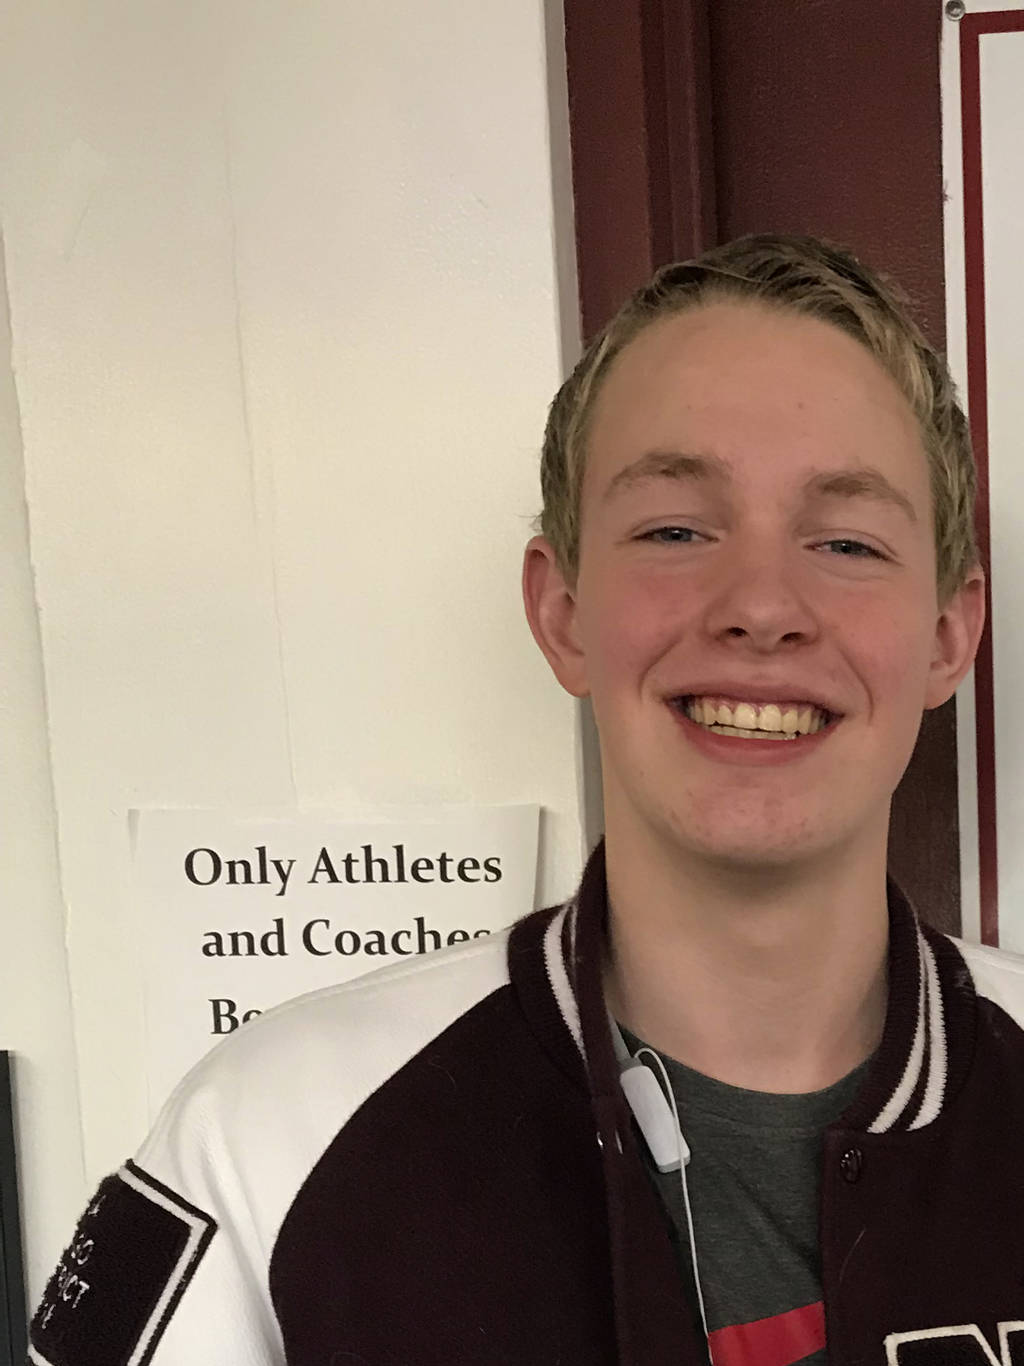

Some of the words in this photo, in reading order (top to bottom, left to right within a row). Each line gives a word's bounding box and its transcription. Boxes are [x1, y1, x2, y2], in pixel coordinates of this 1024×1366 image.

[183, 846, 297, 897] Only
[308, 843, 504, 884] Athletes
[201, 917, 290, 957] and
